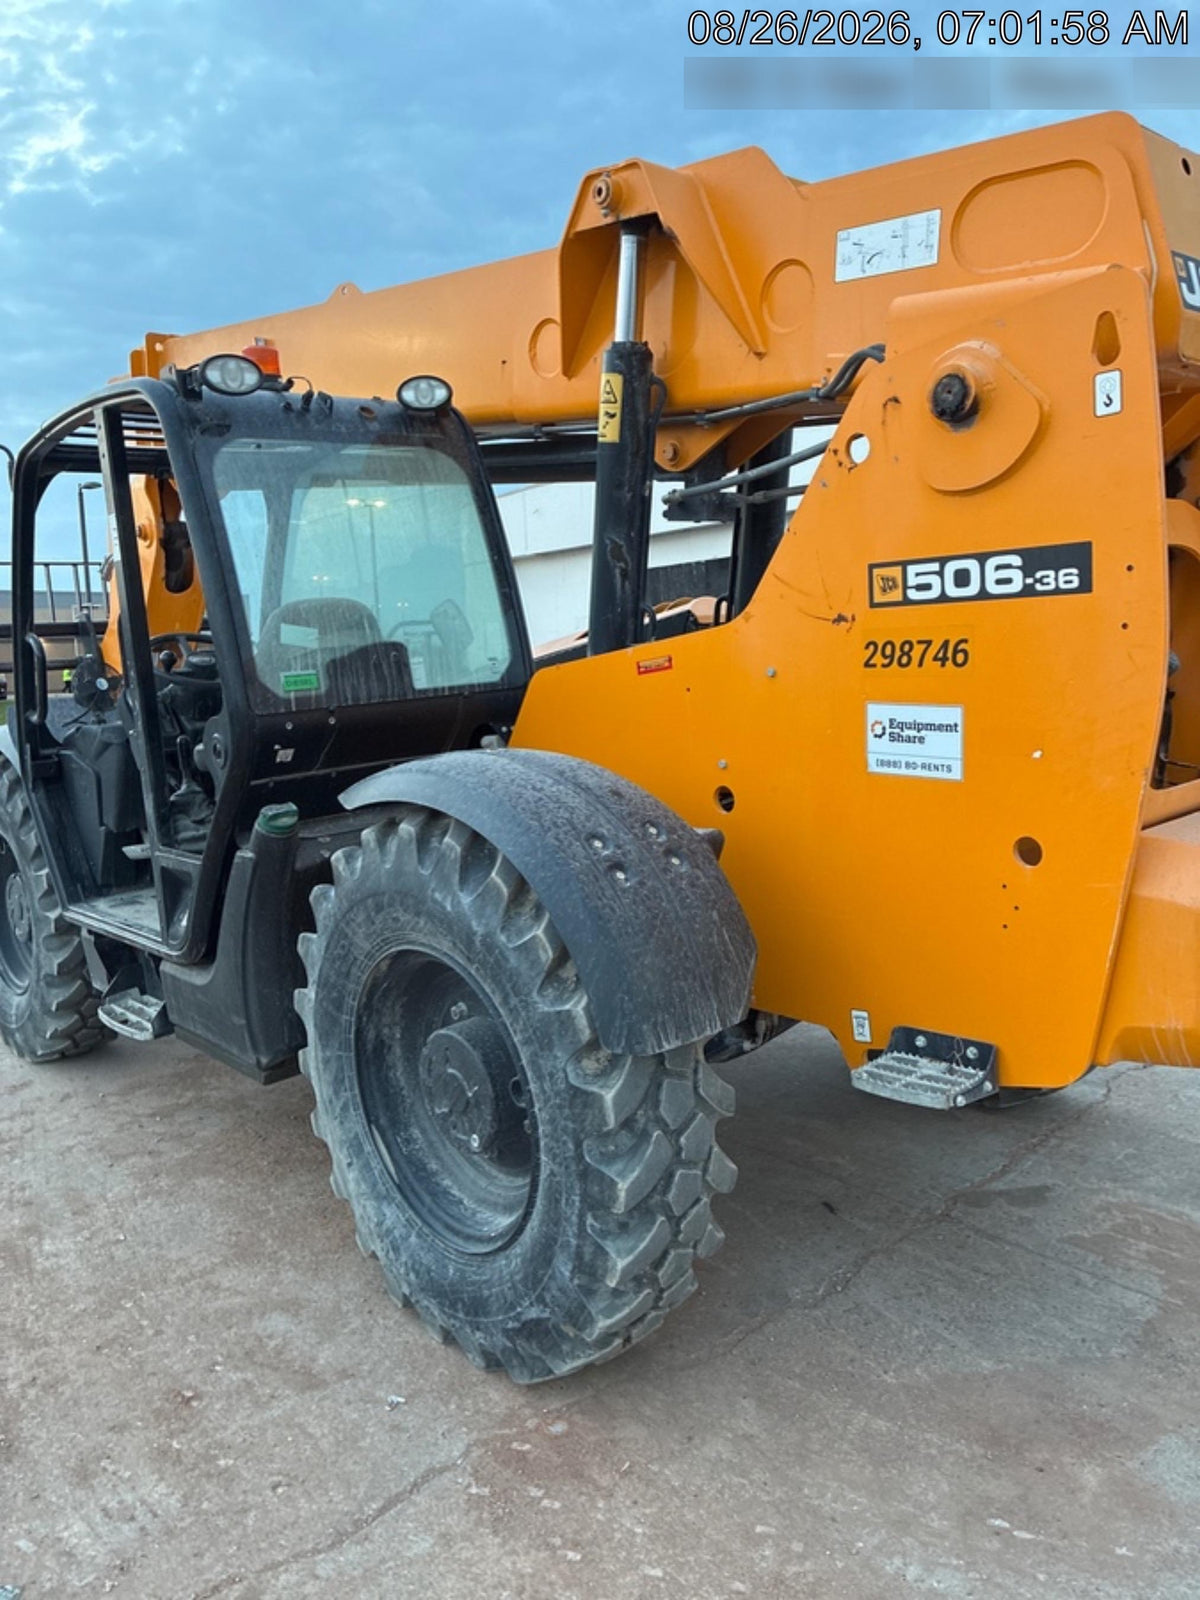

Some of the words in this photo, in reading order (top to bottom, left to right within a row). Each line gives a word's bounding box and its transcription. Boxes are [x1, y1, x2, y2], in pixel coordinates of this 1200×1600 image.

[905, 554, 1080, 600] 506-36
[863, 638, 970, 669] 298746
[888, 717, 960, 734] Equipment
[888, 731, 926, 745] Share
